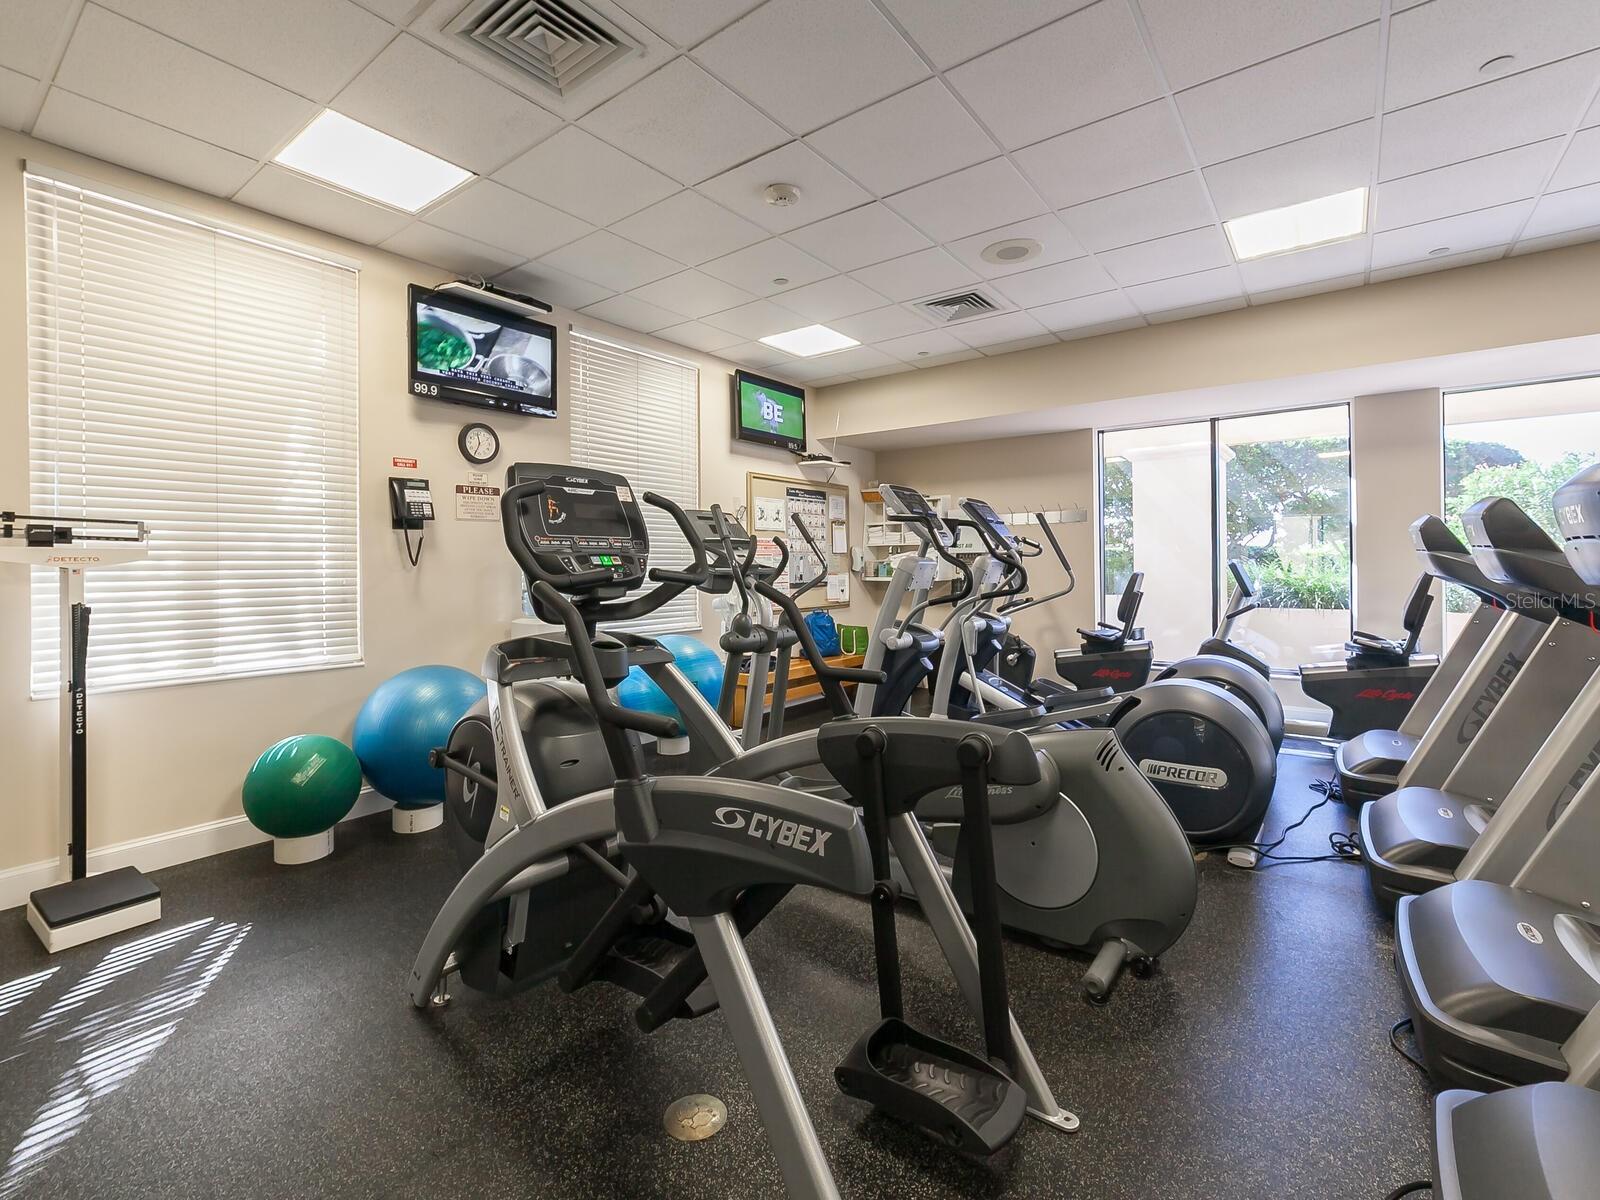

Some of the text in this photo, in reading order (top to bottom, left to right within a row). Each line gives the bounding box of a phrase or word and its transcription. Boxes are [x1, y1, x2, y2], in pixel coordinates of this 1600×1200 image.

[413, 382, 438, 396] 99.9
[763, 401, 784, 423] BE
[462, 486, 495, 496] PLEASE
[75, 693, 84, 734] DETECTO
[1156, 765, 1218, 784] PRECOR
[747, 812, 833, 857] CYBEX
